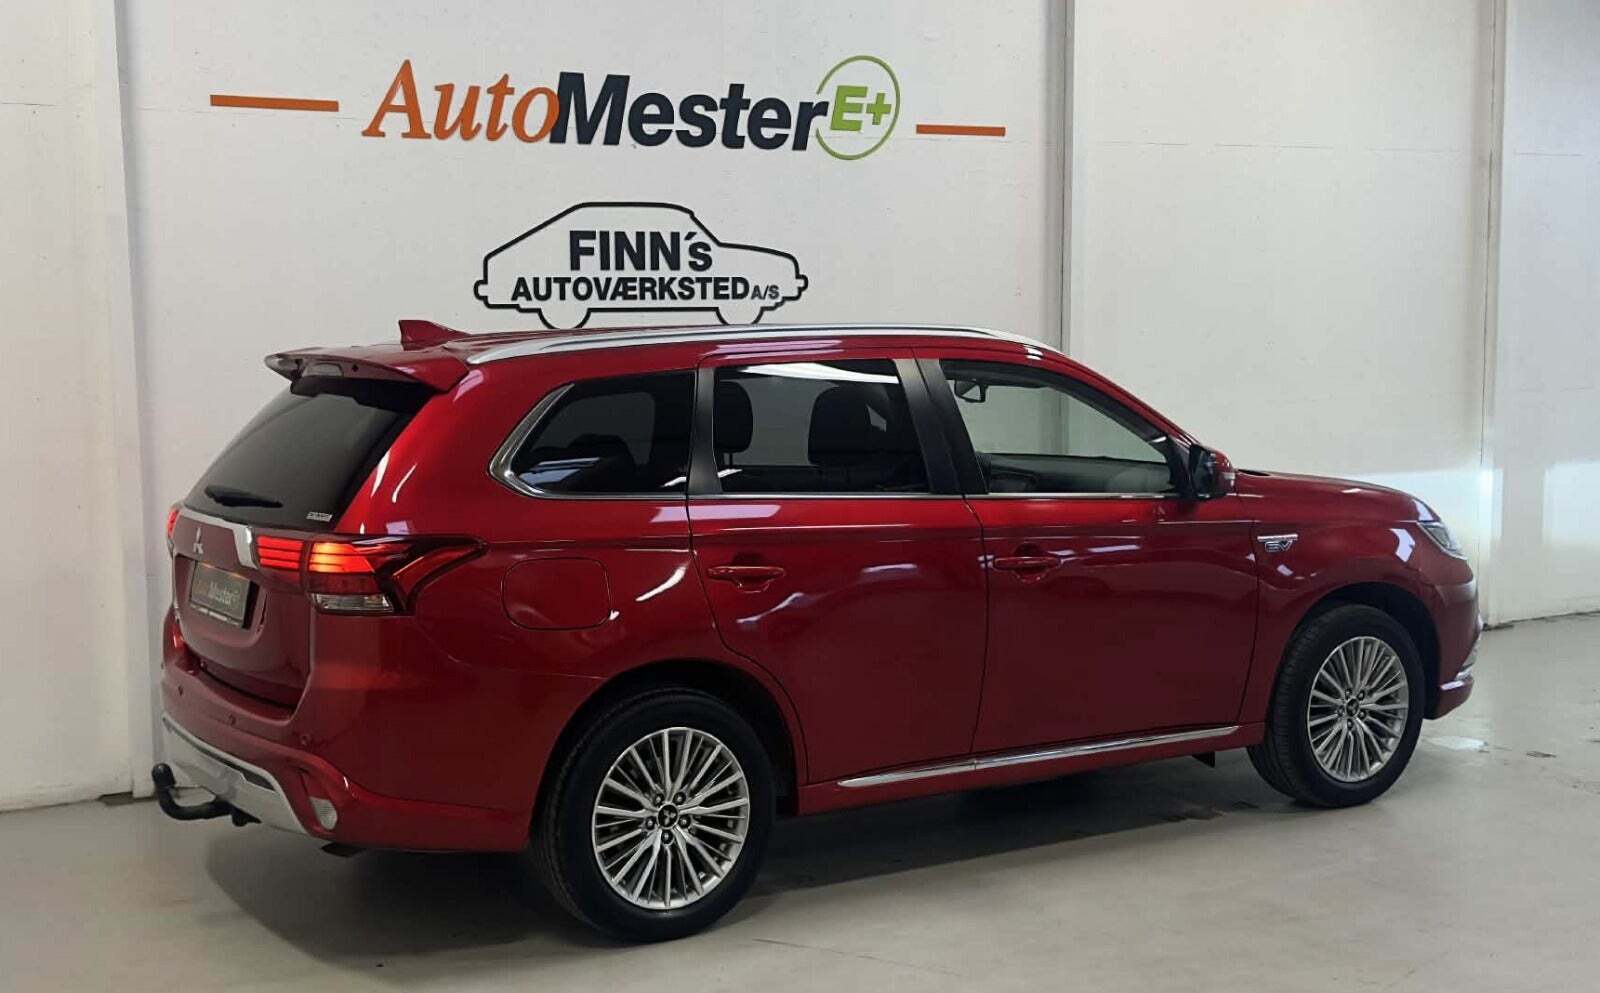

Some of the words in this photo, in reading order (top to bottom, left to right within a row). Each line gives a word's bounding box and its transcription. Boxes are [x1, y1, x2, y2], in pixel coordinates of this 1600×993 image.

[361, 58, 829, 151] AutoMester
[511, 276, 750, 301] AUTOVÆRKSTED
[750, 284, 780, 301] A/S
